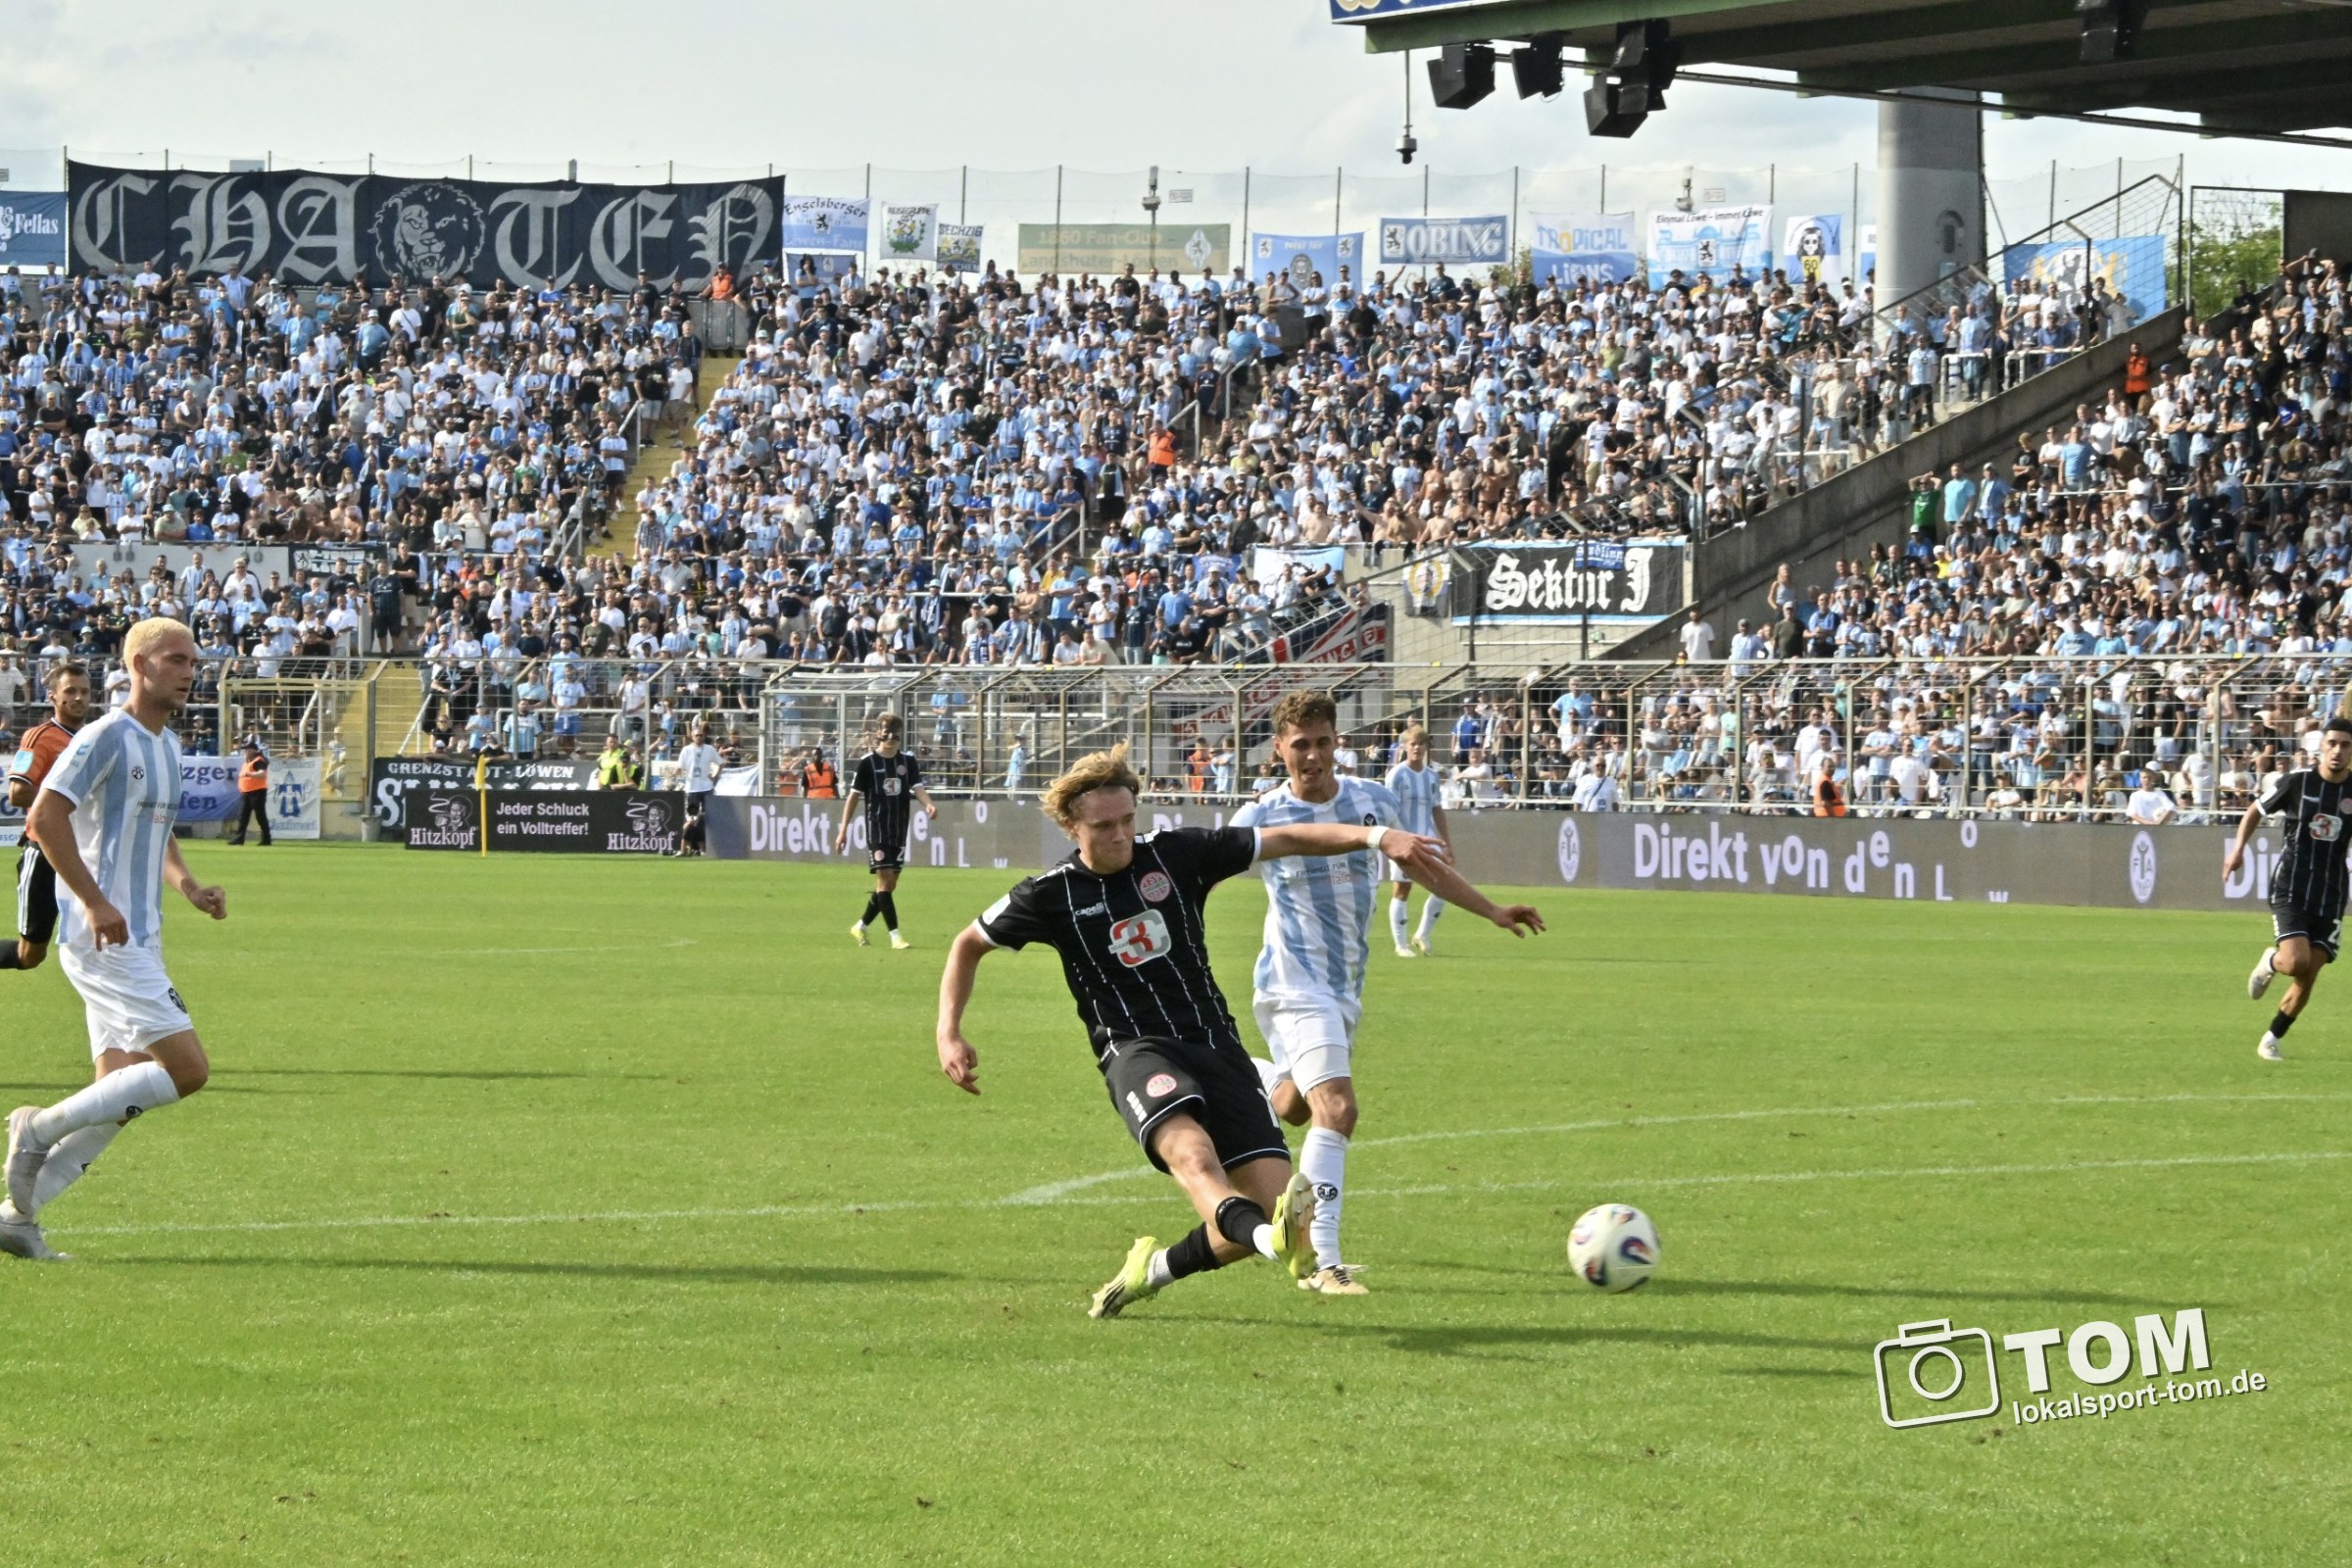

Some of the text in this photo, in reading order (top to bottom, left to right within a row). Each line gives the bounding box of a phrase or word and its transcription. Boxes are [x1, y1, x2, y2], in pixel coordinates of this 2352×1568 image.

[784, 197, 867, 218] Engelsberger
[15, 213, 59, 235] Fellas
[938, 222, 984, 237] SECHZIG
[1656, 215, 1685, 223] Einmal
[1406, 222, 1504, 257] OBING
[514, 762, 575, 778] LÖWEN
[496, 802, 590, 816] Jeder Schluck
[410, 826, 475, 849] Hitzkopf
[497, 821, 589, 836] ein Volltreffer!
[750, 803, 831, 855] Direkt
[607, 830, 674, 854] Hitzkopf
[1634, 821, 1749, 882] Direkt
[1760, 835, 1829, 889] von
[1844, 829, 1915, 899] den
